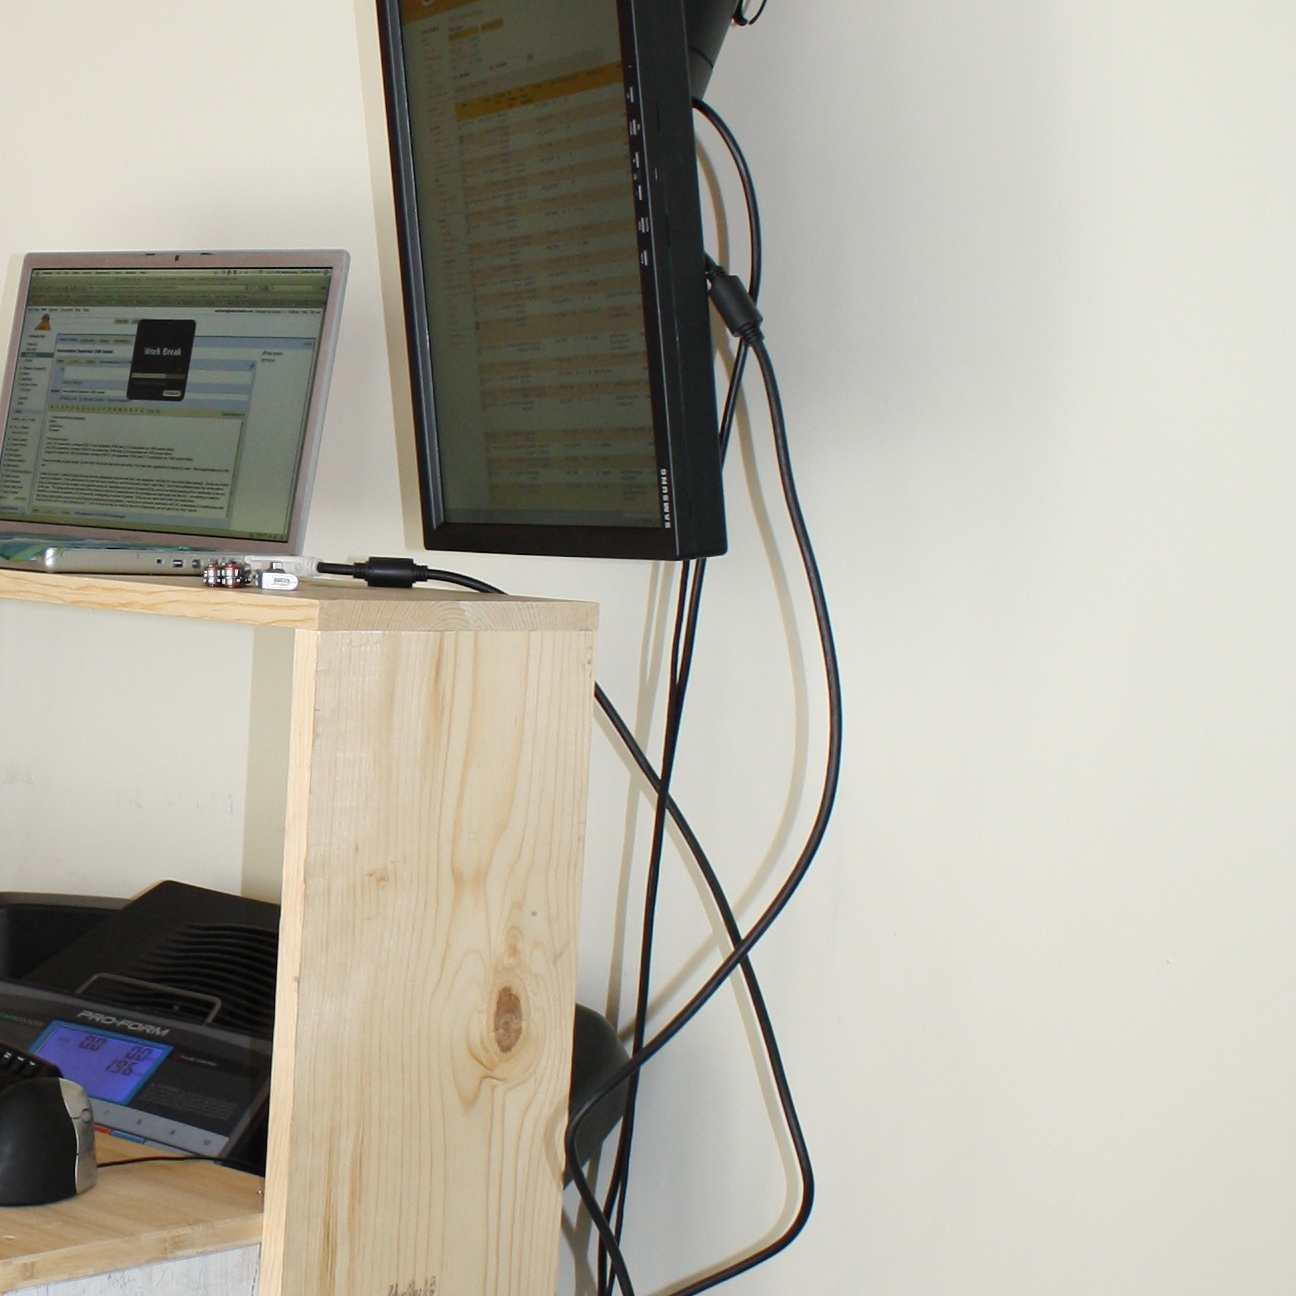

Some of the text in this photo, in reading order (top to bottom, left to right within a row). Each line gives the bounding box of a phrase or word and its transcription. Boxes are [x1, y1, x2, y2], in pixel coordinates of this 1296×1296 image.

[144, 347, 182, 355] Work Break
[660, 468, 671, 529] SAMSUNG
